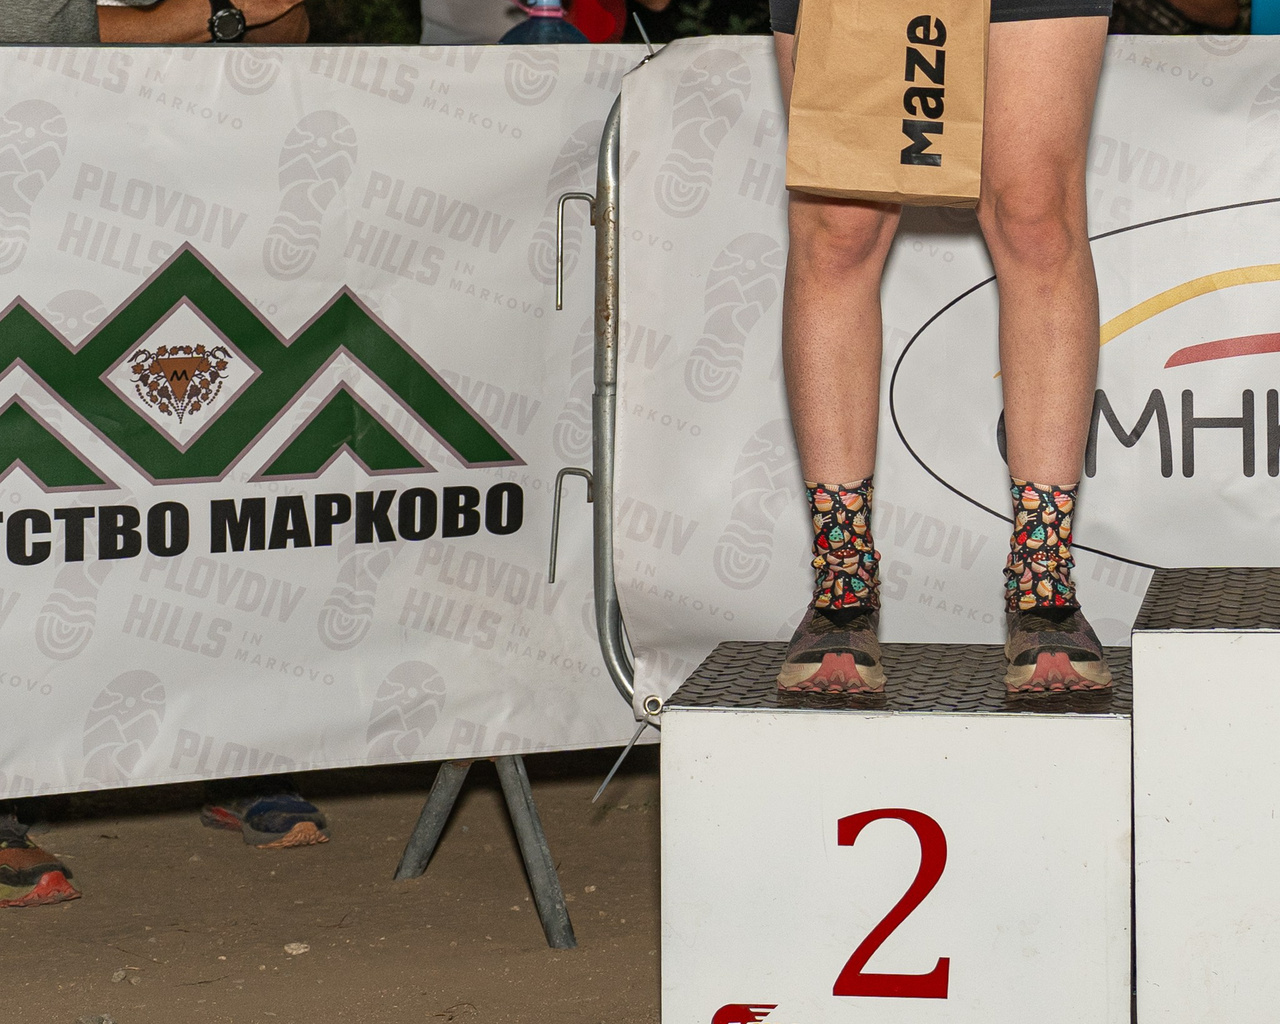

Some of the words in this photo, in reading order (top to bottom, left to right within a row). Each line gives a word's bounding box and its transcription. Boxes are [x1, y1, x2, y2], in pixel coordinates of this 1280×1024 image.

[138, 85, 244, 130] MARKOVO
[430, 79, 451, 95] IN
[900, 14, 947, 167] Maze
[422, 96, 524, 139] MARKOVO
[72, 162, 249, 250] PLOVDIV
[361, 170, 516, 254] PLOVDIV
[343, 220, 446, 286] HILLS
[454, 260, 476, 275] IN
[449, 278, 546, 319] MARKOVO
[0, 501, 191, 567] СТВО
[210, 482, 524, 554] МАРКОВО
[139, 554, 307, 625] PLOVDIV
[414, 540, 567, 616] PLOVDIV
[634, 560, 657, 577] IN
[923, 576, 946, 592] IN
[398, 587, 503, 650] HILLS
[631, 578, 735, 623] MARKOVO
[122, 593, 233, 659] HILLS
[242, 630, 263, 647] IN
[510, 623, 531, 639] IN
[234, 648, 335, 686] MARKOVO
[505, 640, 602, 678] MARKOVO
[833, 808, 950, 999] 2
